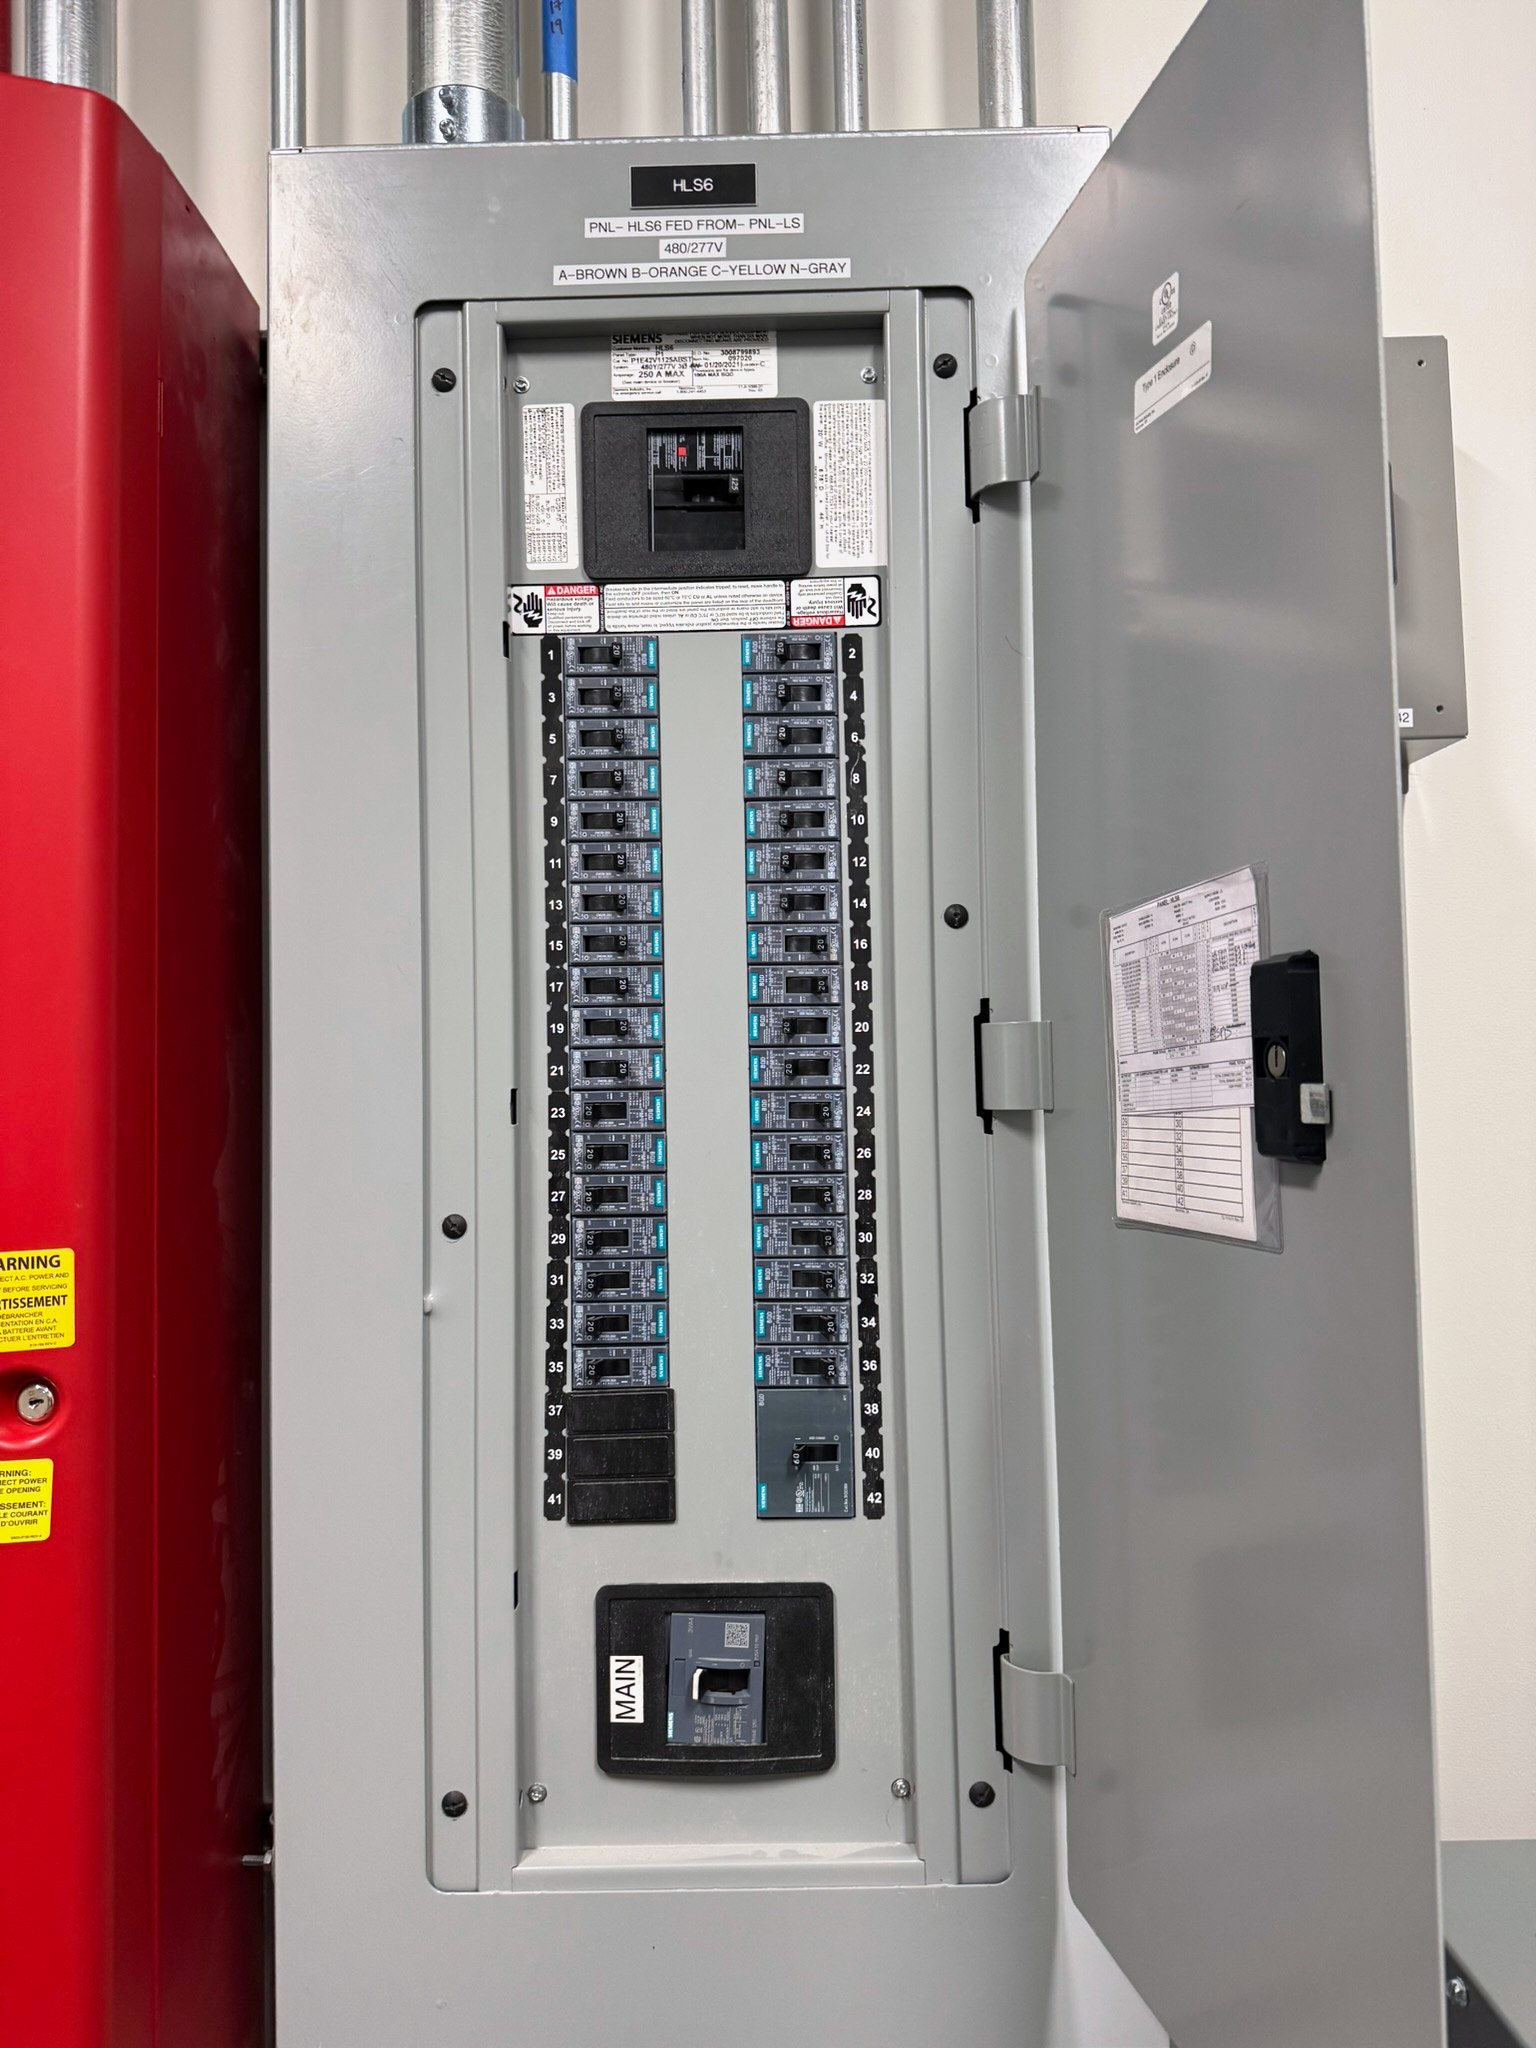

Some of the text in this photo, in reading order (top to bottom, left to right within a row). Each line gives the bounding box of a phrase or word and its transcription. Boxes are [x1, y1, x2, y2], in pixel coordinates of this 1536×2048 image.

[673, 177, 714, 192] HLS6
[589, 217, 801, 233] PNL- HLS6 FED FROM- PNL-LS
[664, 241, 724, 254] 480/277V
[558, 261, 847, 281] A-BROWN B-ORANGE C-YELLOW N-GRAY
[612, 334, 663, 345] SIEMENS
[638, 371, 654, 379] 250
[731, 477, 739, 491] 125
[556, 586, 596, 595] DANGER
[793, 616, 833, 626] DANGER
[612, 645, 621, 655] 20
[776, 642, 785, 652] 20
[547, 649, 554, 661] 1
[848, 647, 856, 659] 2
[614, 686, 622, 696] 20
[777, 685, 786, 695] 20
[849, 690, 858, 701] 4
[548, 691, 556, 703] 3
[778, 727, 786, 737] 20
[850, 731, 859, 743] 6
[548, 733, 557, 745] 5
[549, 774, 558, 786] 7
[613, 770, 622, 781] 20
[778, 771, 786, 781] 20
[852, 772, 860, 784] 8
[550, 815, 559, 827] 9
[616, 813, 624, 823] 20
[850, 814, 865, 826] 10
[548, 857, 562, 869] 11
[617, 855, 625, 864] 20
[781, 855, 790, 864] 20
[852, 856, 867, 868] 12
[548, 899, 564, 911] 13
[780, 898, 788, 907] 20
[852, 897, 868, 909] 14
[548, 940, 564, 951] 15
[618, 935, 627, 945] 20
[853, 938, 868, 950] 16
[549, 981, 564, 993] 17
[618, 979, 627, 989] 20
[854, 980, 869, 991] 18
[549, 1022, 565, 1034] 19
[854, 1021, 870, 1033] 20
[549, 1064, 564, 1077] 21
[619, 1064, 627, 1073] 20
[785, 1064, 793, 1073] 20
[855, 1063, 871, 1075] 22
[550, 1107, 566, 1119] 23
[822, 1107, 830, 1116] 20
[856, 1105, 872, 1117] 24
[1121, 1117, 1129, 1126] 29
[1175, 1119, 1183, 1128] 30
[1121, 1130, 1129, 1138] 31
[1175, 1132, 1183, 1141] 32
[1121, 1142, 1129, 1150] 33
[1175, 1144, 1183, 1154] 34
[550, 1149, 566, 1161] 25
[586, 1149, 594, 1159] 20
[823, 1149, 831, 1159] 20
[856, 1147, 872, 1159] 26
[1121, 1153, 1129, 1161] 35
[1175, 1157, 1183, 1167] 36
[1121, 1165, 1129, 1173] 37
[1176, 1170, 1184, 1180] 38
[1121, 1177, 1129, 1186] 39
[1121, 1189, 1129, 1197] 41
[1176, 1184, 1184, 1193] 40
[550, 1190, 566, 1202] 27
[823, 1192, 831, 1201] 20
[857, 1189, 873, 1201] 28
[1176, 1197, 1184, 1206] 42
[551, 1233, 567, 1245] 29
[858, 1231, 873, 1243] 30
[550, 1274, 564, 1286] 31
[586, 1279, 595, 1288] 20
[825, 1278, 833, 1288] 20
[859, 1272, 875, 1285] 32
[32, 1283, 68, 1291] SERVICING
[0, 1295, 68, 1310] TISSEMENT
[549, 1318, 565, 1330] 33
[827, 1322, 835, 1332] 20
[861, 1316, 877, 1328] 34
[548, 1361, 564, 1373] 35
[827, 1365, 835, 1375] 20
[862, 1359, 878, 1371] 36
[548, 1404, 564, 1417] 37
[864, 1402, 879, 1416] 38
[547, 1448, 563, 1461] 39
[864, 1447, 881, 1459] 40
[792, 1454, 800, 1464] 60
[6, 1486, 41, 1494] OPENING
[547, 1493, 562, 1505] 41
[866, 1491, 883, 1504] 42
[10, 1510, 48, 1518] COURANT
[614, 1658, 636, 1720] MAIN
